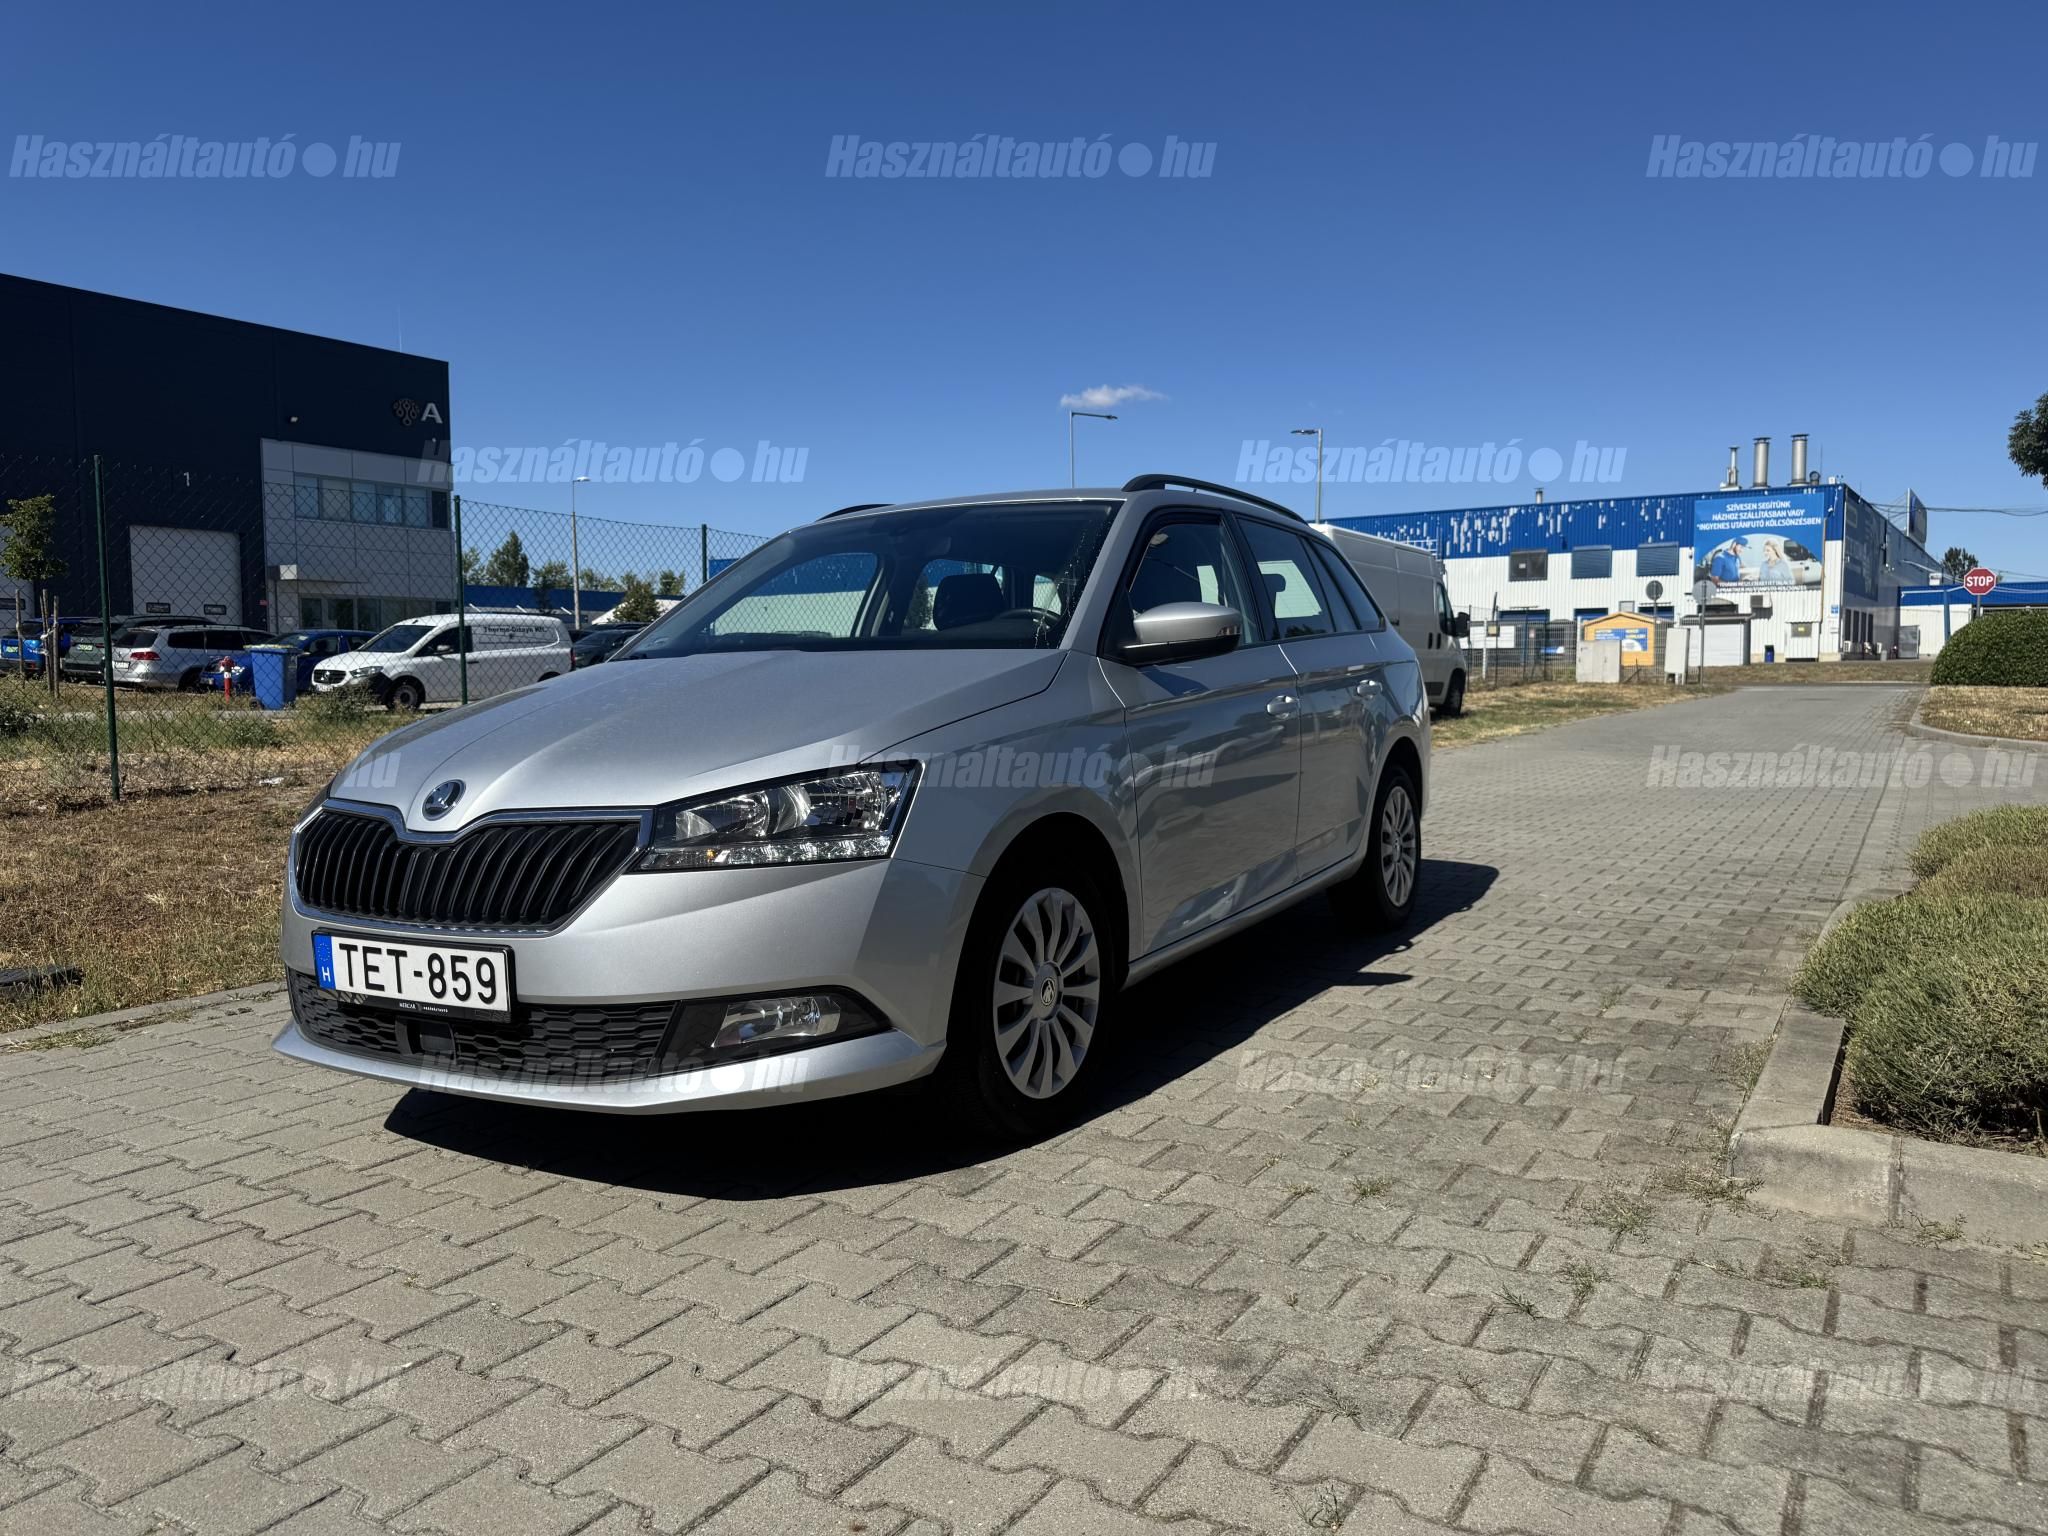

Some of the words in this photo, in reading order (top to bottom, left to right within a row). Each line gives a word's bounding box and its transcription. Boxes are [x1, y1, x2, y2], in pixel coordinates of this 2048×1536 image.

[421, 402, 443, 424] A
[1726, 503, 1758, 512] SZÍVESEN
[1759, 500, 1791, 510] SEGÍTÜNK
[1712, 511, 1739, 521] HÁZHOZ
[1787, 508, 1805, 517] VAGY
[1966, 576, 1993, 587] STOP
[321, 966, 331, 983] H
[338, 943, 497, 1005] TET-859
